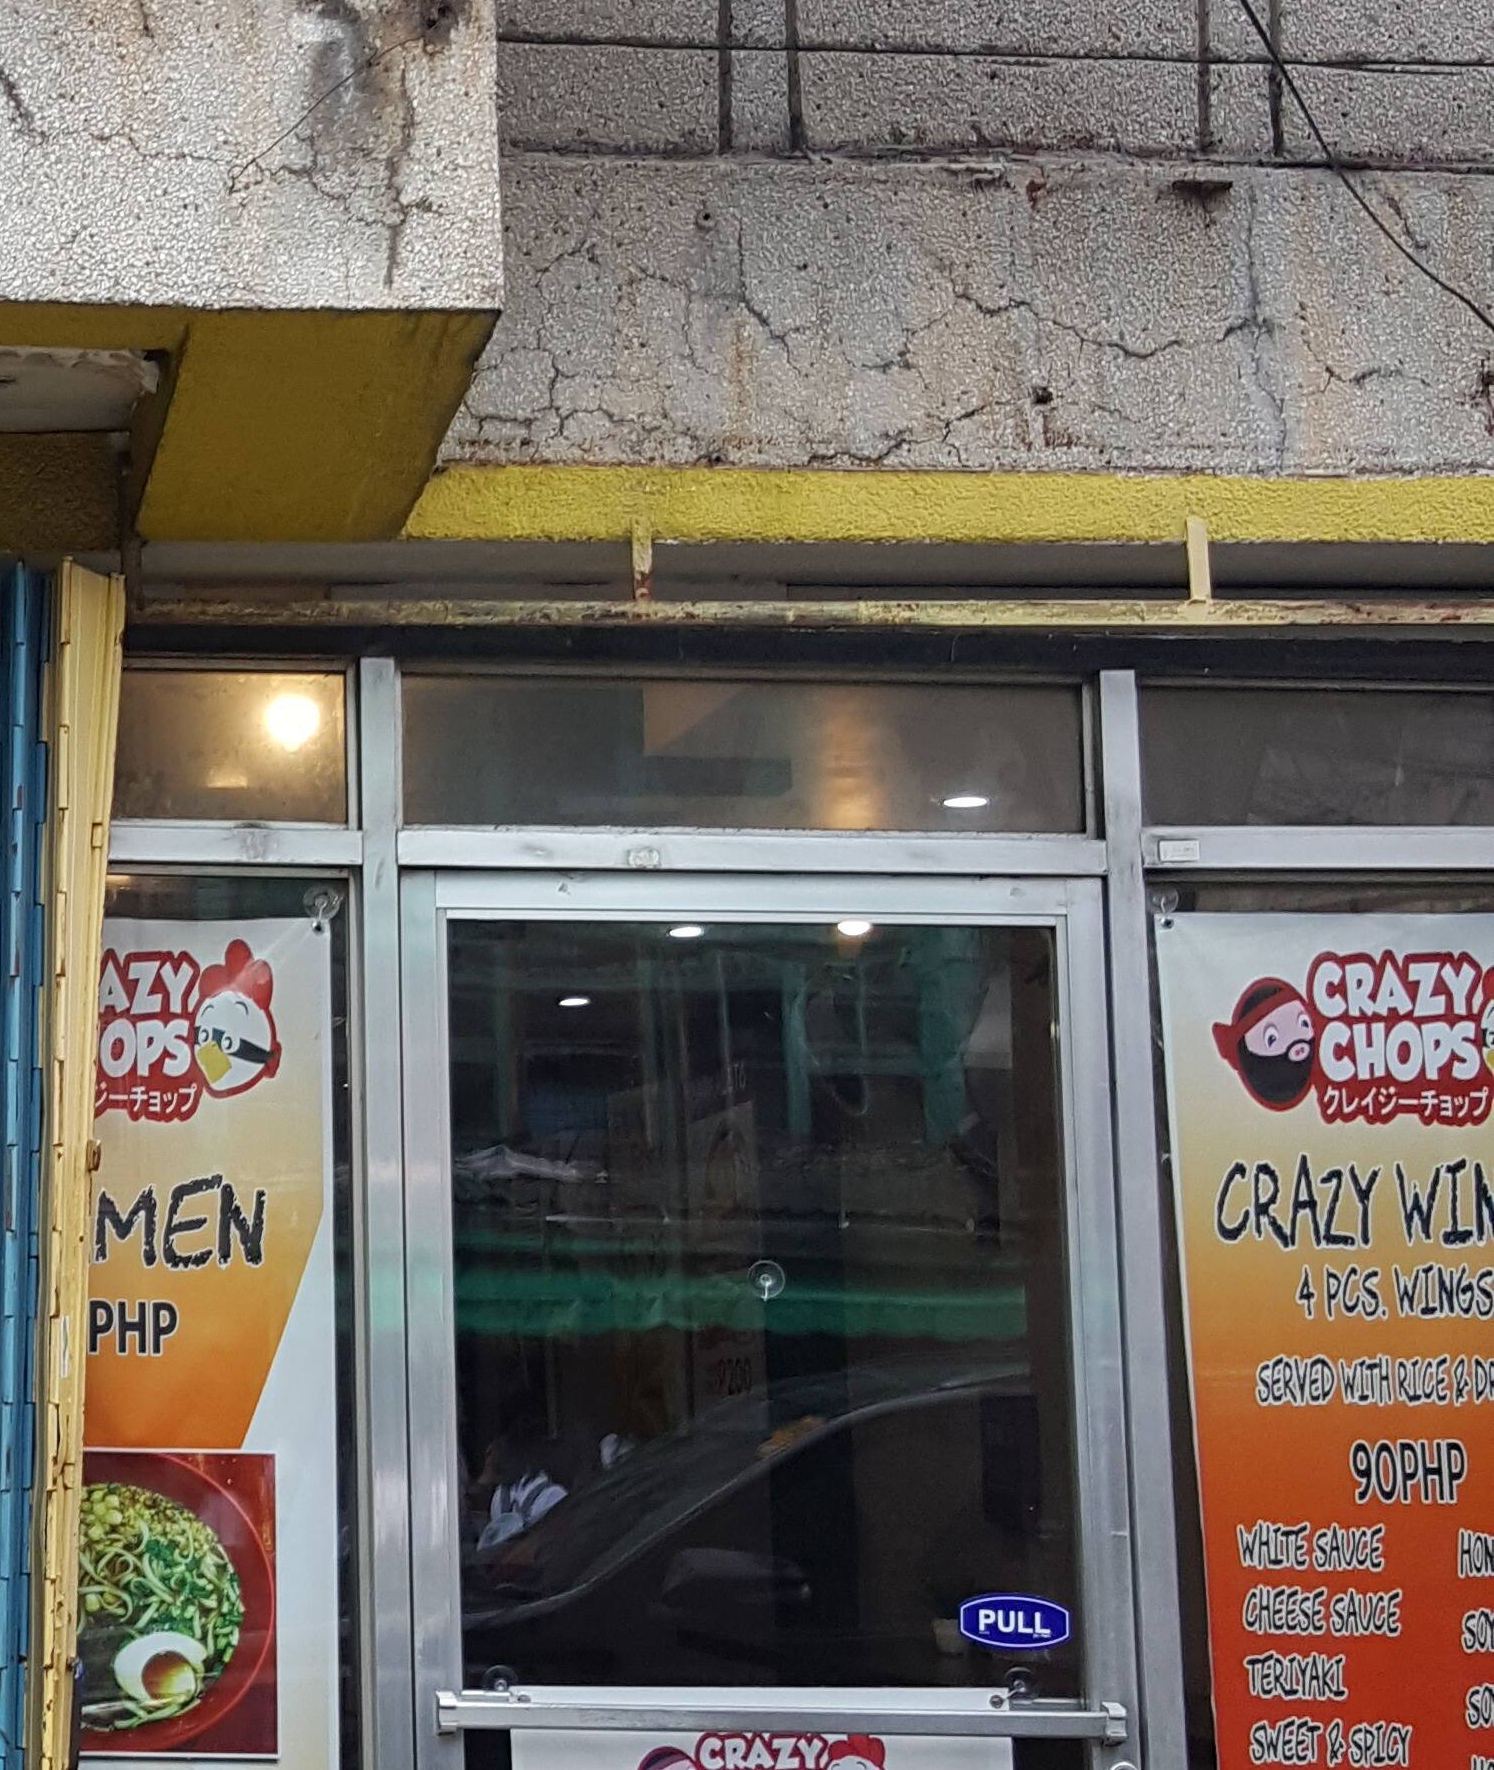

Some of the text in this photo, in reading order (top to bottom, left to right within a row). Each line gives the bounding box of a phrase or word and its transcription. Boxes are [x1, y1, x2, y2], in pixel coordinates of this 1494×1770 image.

[98, 958, 194, 1015] AZY
[1312, 960, 1477, 1018] CRAZY
[99, 1017, 192, 1078] OPS
[1318, 1020, 1481, 1082] CHOPS
[1324, 1084, 1489, 1118] クレイジーチョップ
[95, 1173, 266, 1269] MEN
[1216, 1153, 1494, 1248] CRAZY WIN
[1298, 1263, 1494, 1318] 4 PCS. WINGS
[1257, 1356, 1335, 1404] SERVED
[1340, 1355, 1392, 1405] WITH
[1397, 1355, 1449, 1404] RICE
[1453, 1357, 1470, 1405] &
[1352, 1441, 1466, 1502] 90PHP
[1238, 1523, 1383, 1569] WHITE SAUCE
[1459, 1529, 1494, 1576] HON
[978, 1608, 1051, 1634] PULL
[1245, 1588, 1401, 1634] CHEESE SAUCE
[1246, 1653, 1346, 1698] TERIYAKI
[1467, 1687, 1494, 1726] SO
[699, 1736, 824, 1770] CRAZY
[1252, 1719, 1410, 1764] SWEET & SPICY
